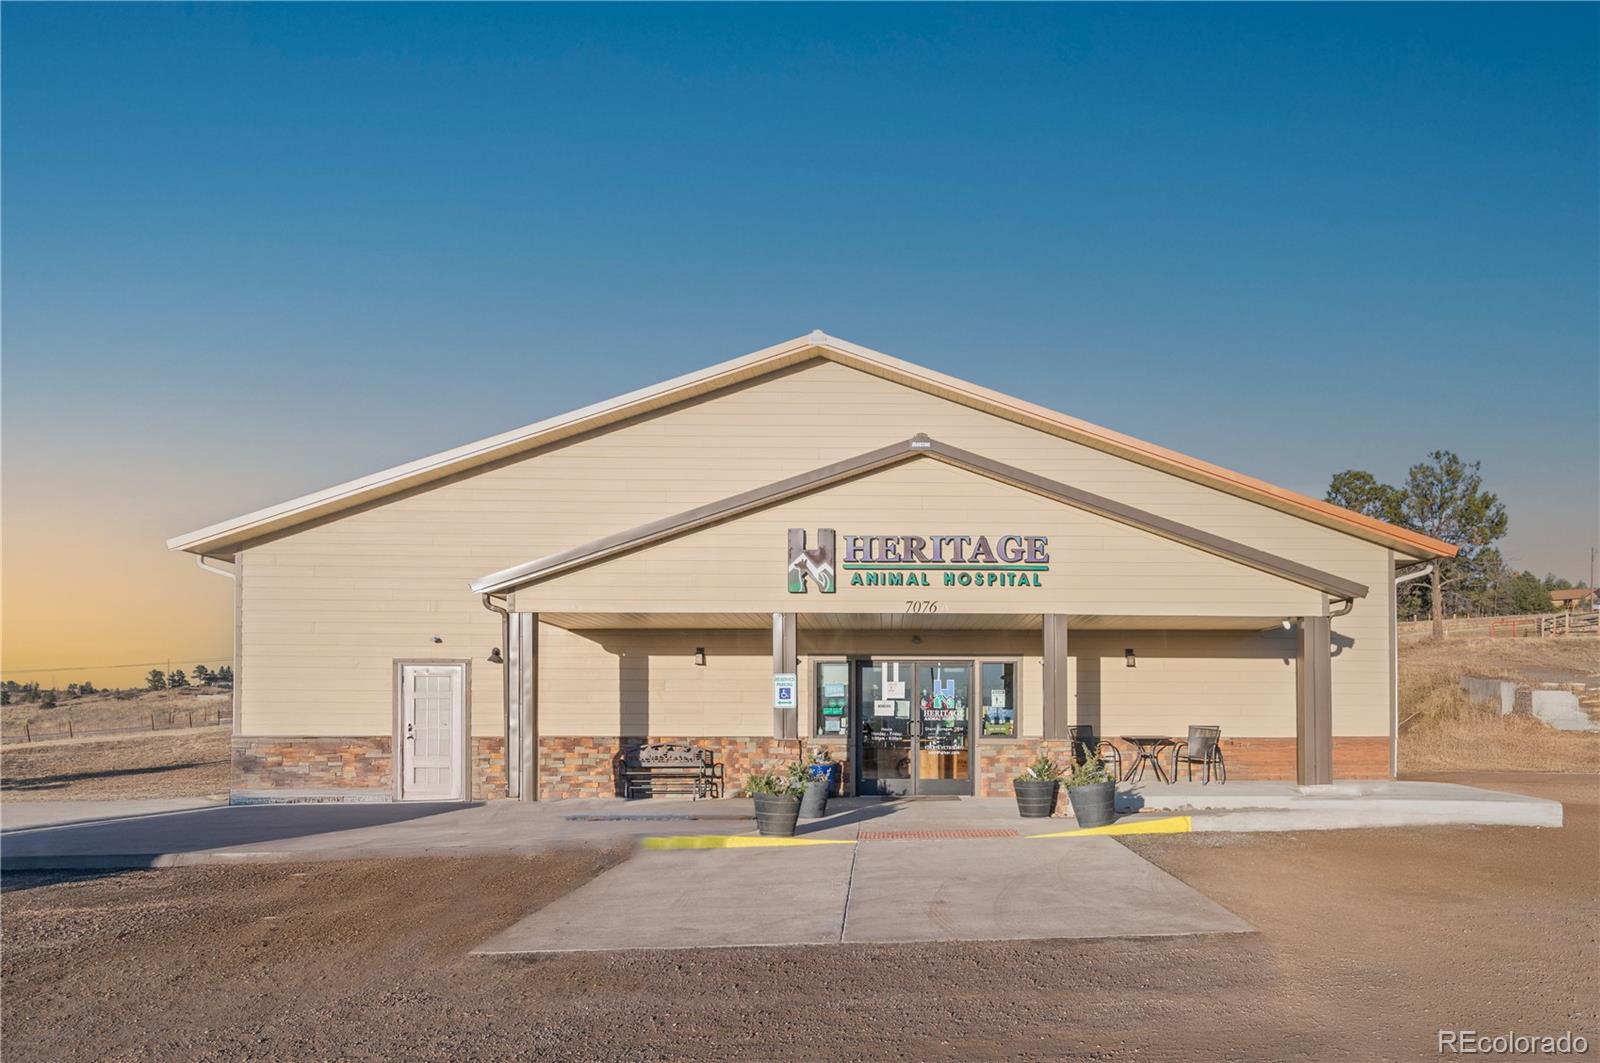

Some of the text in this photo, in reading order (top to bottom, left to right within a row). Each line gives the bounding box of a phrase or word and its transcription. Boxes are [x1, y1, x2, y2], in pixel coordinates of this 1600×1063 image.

[843, 535, 1050, 563] HERITAGE
[851, 572, 1042, 587] ANIMAL HOSPITAL
[905, 600, 938, 613] 7076
